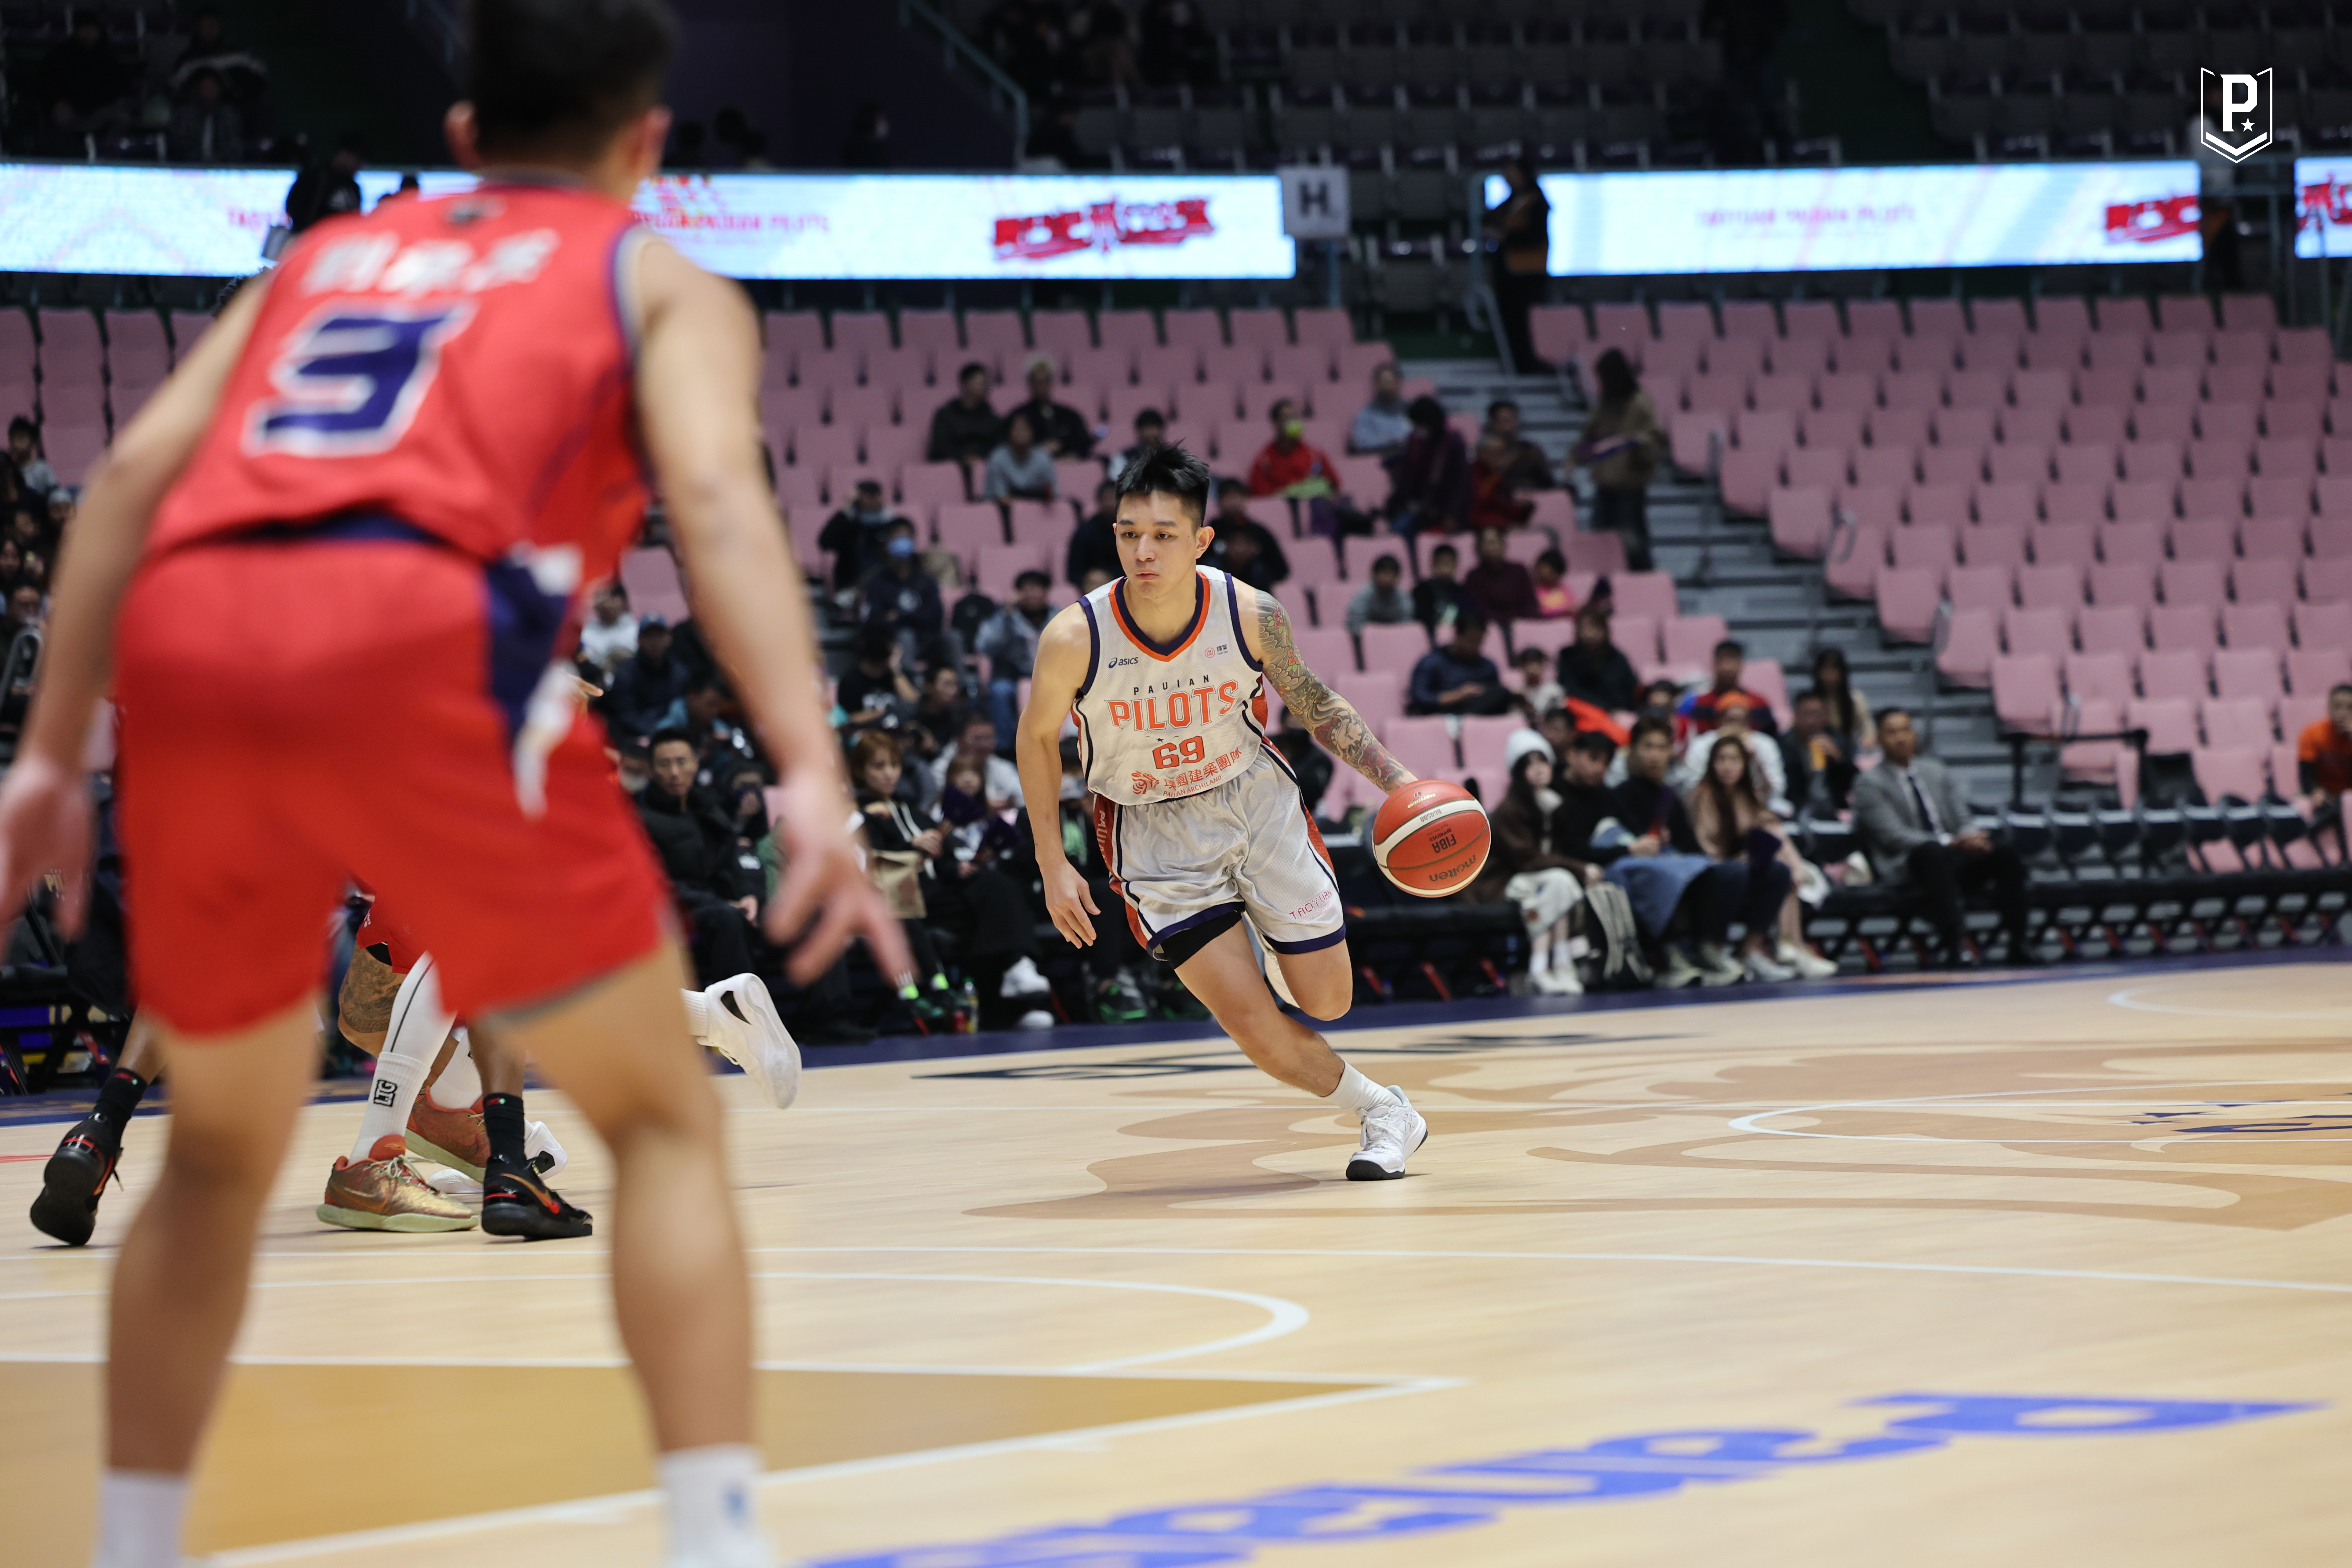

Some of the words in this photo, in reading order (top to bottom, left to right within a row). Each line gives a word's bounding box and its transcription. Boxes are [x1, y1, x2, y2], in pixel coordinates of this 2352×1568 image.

[1299, 180, 1329, 217] H
[1118, 657, 1138, 666] asics
[1134, 675, 1209, 695] PAUIAN
[1104, 679, 1238, 731] PILOTS
[1152, 736, 1205, 769] 69
[1187, 775, 1222, 793] ARCHILAND
[1420, 809, 1442, 822] BG4500
[1432, 834, 1457, 853] FIBA
[1429, 855, 1477, 881] molten
[1289, 889, 1332, 920] TAOYUAN
